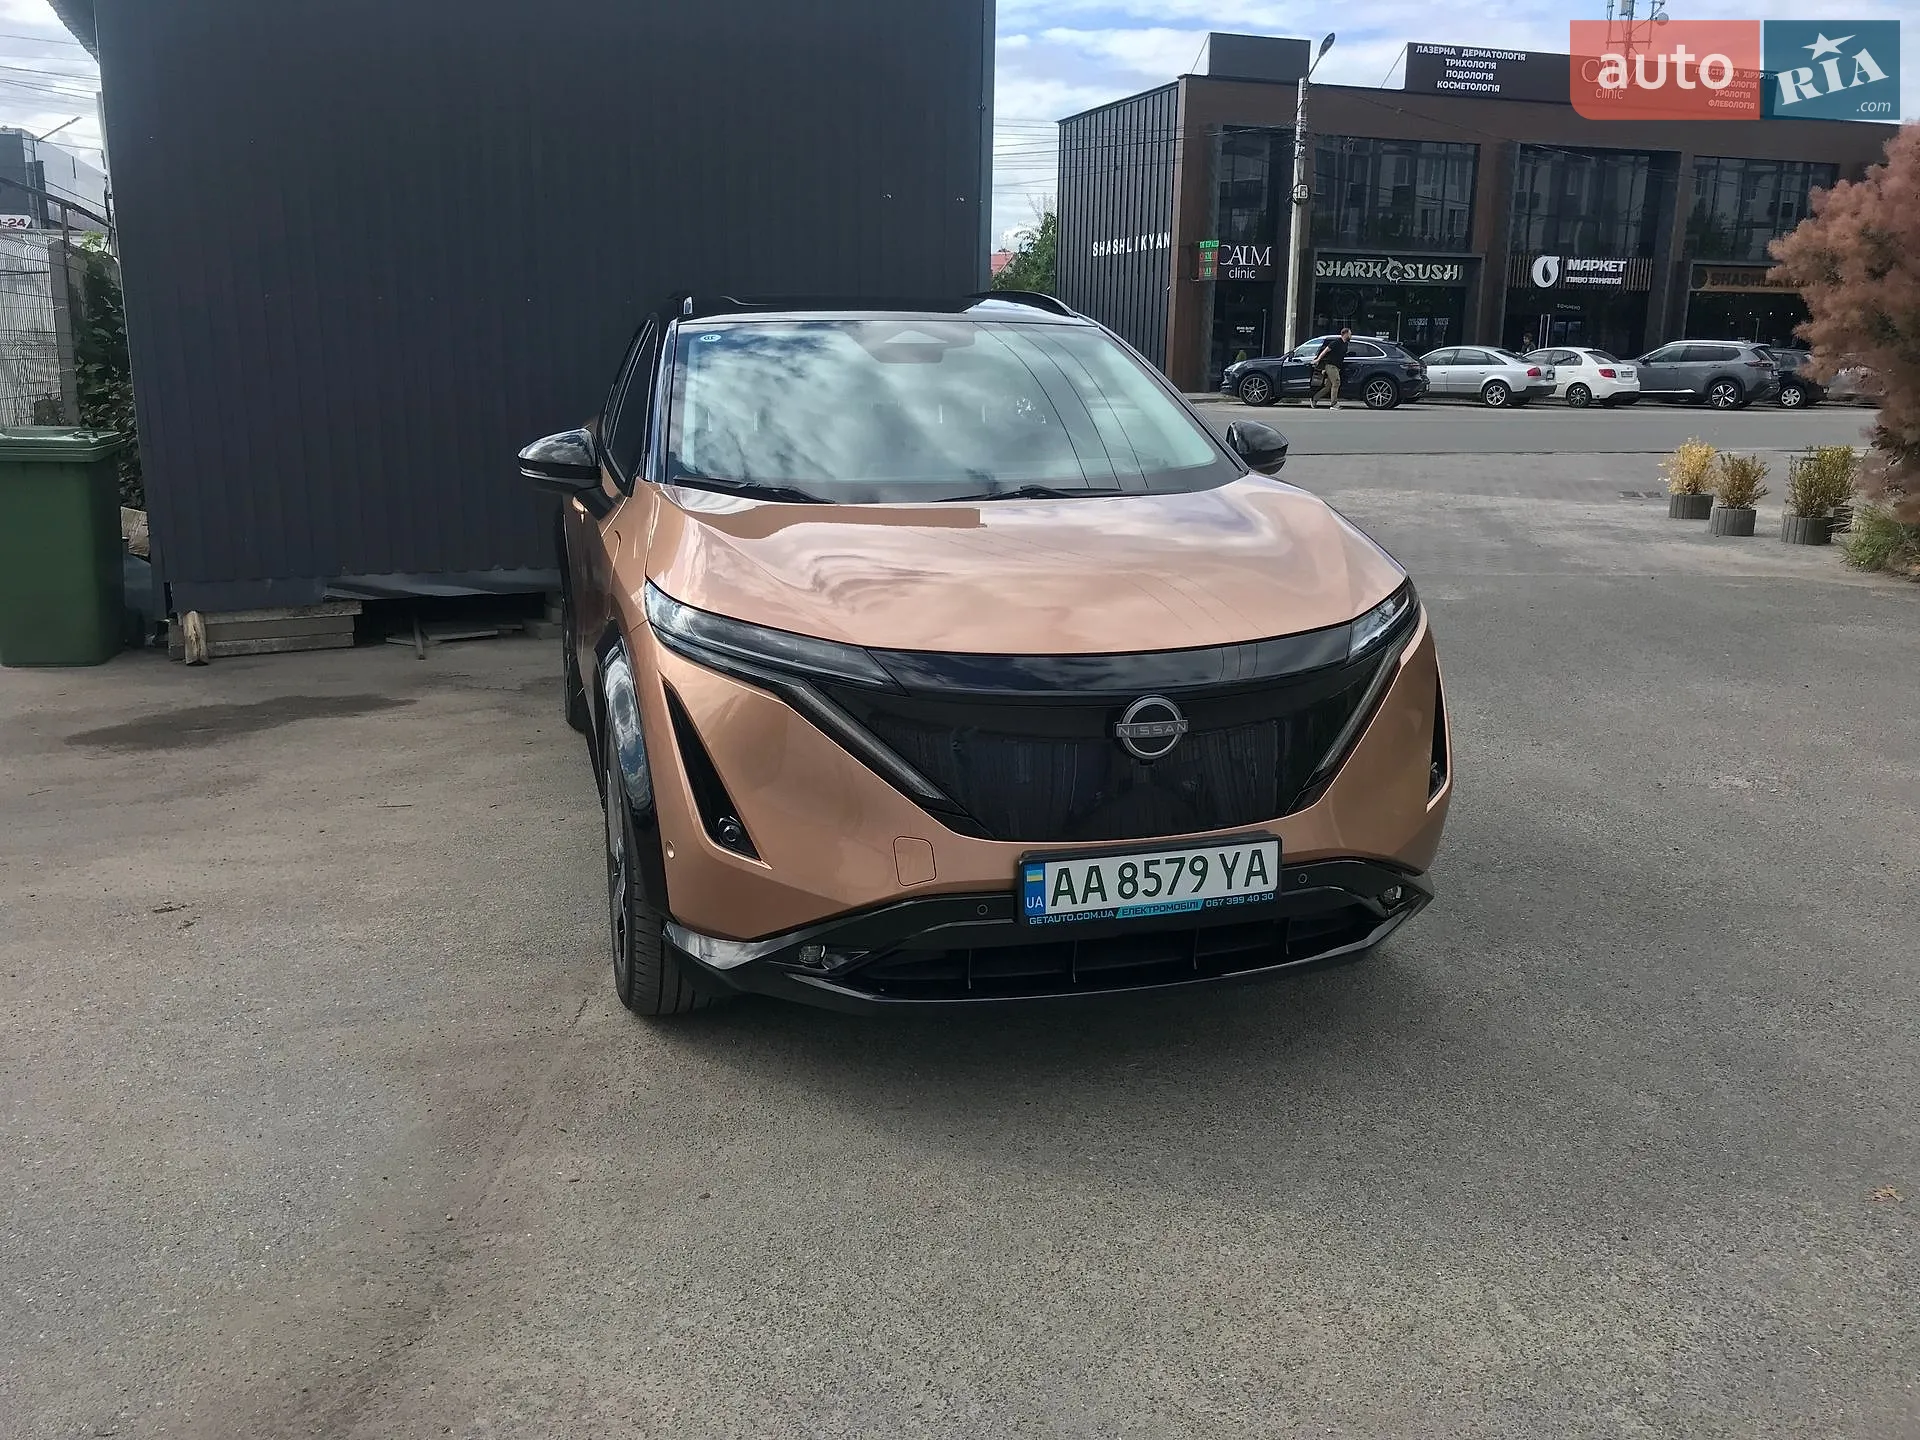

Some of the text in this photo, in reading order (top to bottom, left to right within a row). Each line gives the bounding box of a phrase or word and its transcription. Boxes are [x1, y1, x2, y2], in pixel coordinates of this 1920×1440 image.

[1416, 45, 1526, 61] ЛАЗЕРНА ДЕРМАТОЛОГІЯ
[1445, 58, 1497, 70] ТРИХОЛОГІЯ
[1445, 69, 1494, 81] ПОДОЛОГІЯ
[1436, 80, 1500, 93] КОСМЕТОЛОГІЯ
[1595, 88, 1624, 100] clinic
[1715, 89, 1751, 99] УРОЛОГІЯ
[1708, 99, 1755, 111] ФЛЕБОЛОГІЯ
[0, 218, 26, 228] -24
[1092, 231, 1170, 257] SHASHLIKYAN
[1315, 260, 1464, 281] SHARK SUSHI
[1566, 259, 1627, 272] МАРКЕТ
[1228, 267, 1256, 279] clinic
[1118, 722, 1187, 737] NISSAN
[1051, 848, 1269, 907] AA 8579 YA
[1026, 896, 1044, 909] UA
[1029, 892, 1275, 925] GETAUTO.COM.UA ЕЛЕКТРОМОБІЛІ 067 399 40 30
